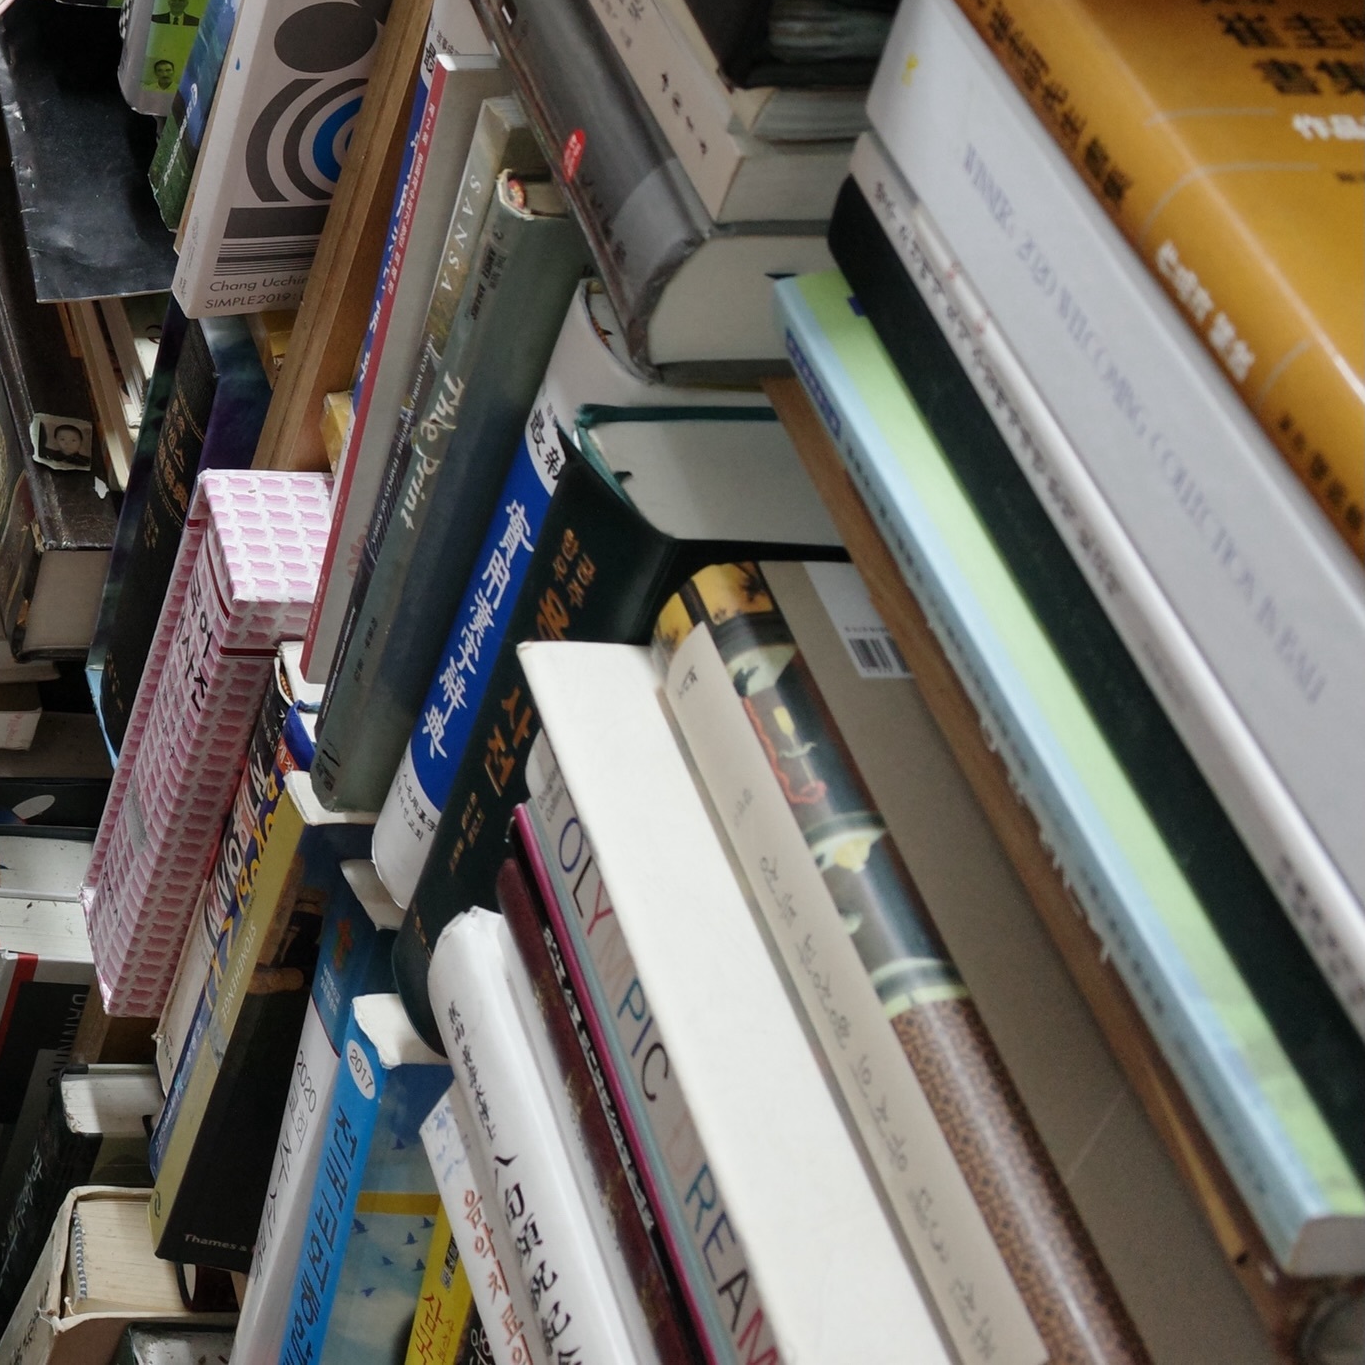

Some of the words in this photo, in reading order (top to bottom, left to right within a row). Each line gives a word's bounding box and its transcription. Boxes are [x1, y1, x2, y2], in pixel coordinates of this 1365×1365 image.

[440, 173, 483, 296] SANSA
[209, 278, 256, 292] Chang
[418, 370, 465, 443] The
[398, 444, 439, 530] Print
[221, 923, 257, 1023] STONEHENGE
[553, 816, 674, 1101] OLYMPIC
[346, 1047, 376, 1090] 2017
[183, 1233, 238, 1252] Thames
